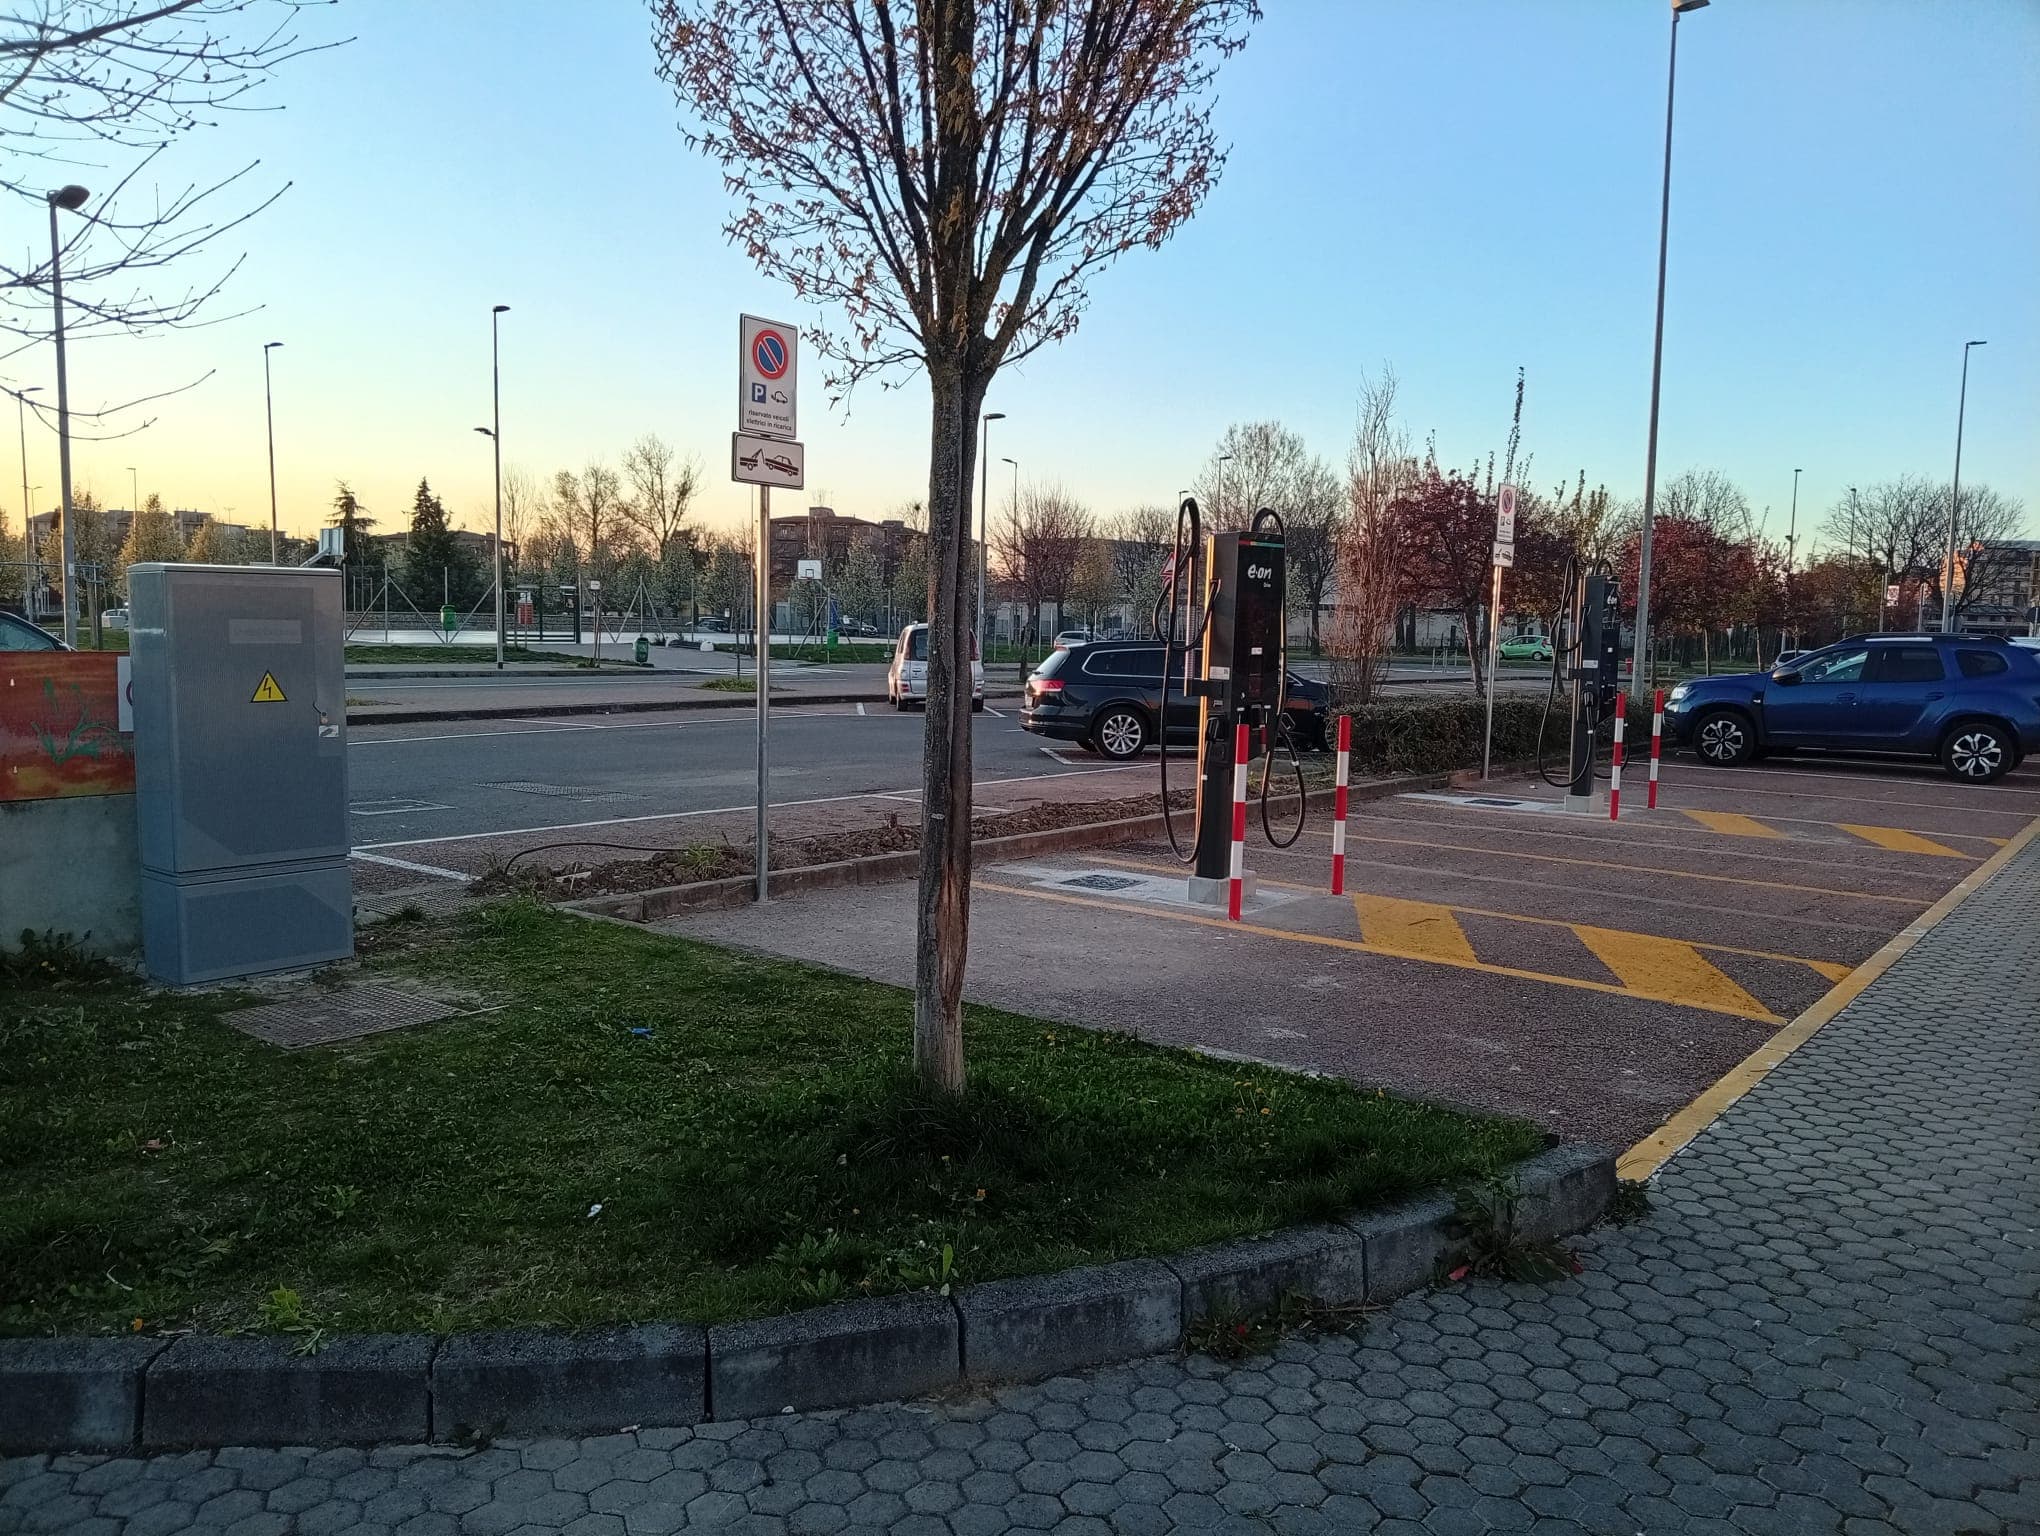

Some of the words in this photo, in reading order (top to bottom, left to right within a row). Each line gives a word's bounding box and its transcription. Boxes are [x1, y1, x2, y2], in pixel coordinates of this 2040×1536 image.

[754, 385, 764, 400] P
[748, 410, 771, 418] riservato
[746, 418, 766, 426] elettrici
[773, 423, 792, 431] ricarica
